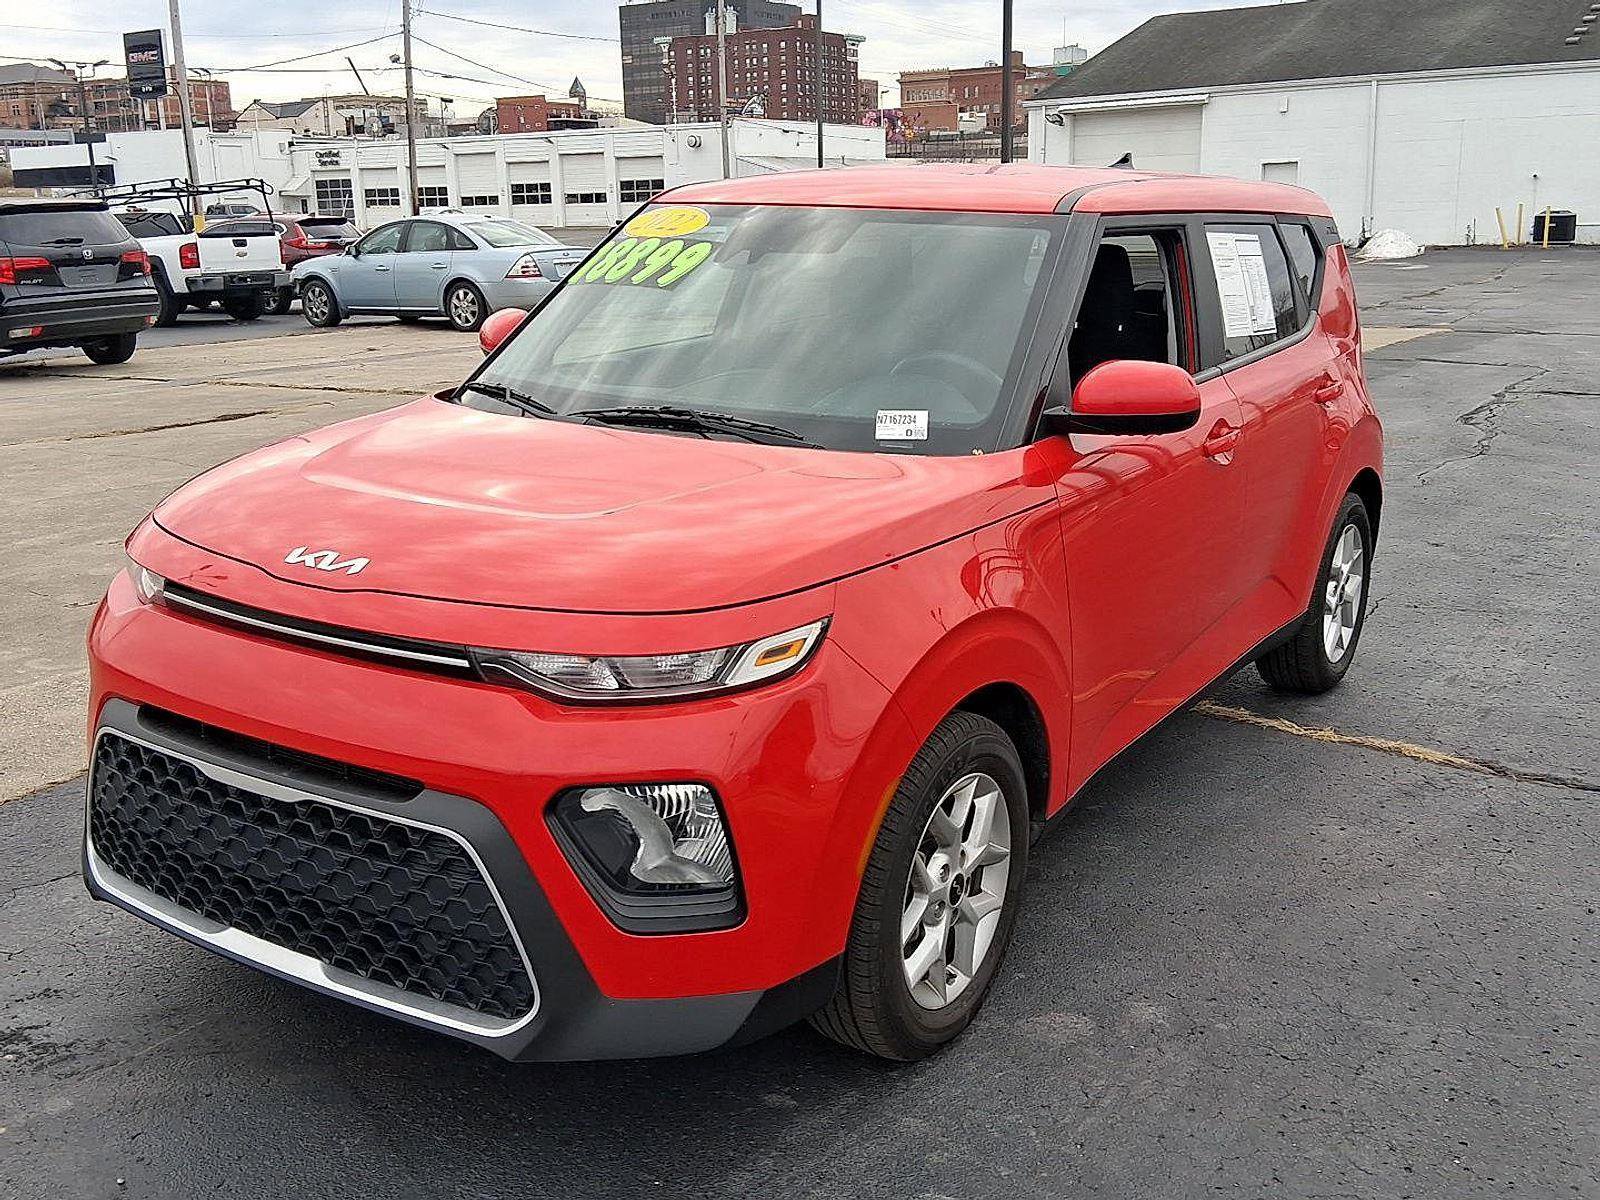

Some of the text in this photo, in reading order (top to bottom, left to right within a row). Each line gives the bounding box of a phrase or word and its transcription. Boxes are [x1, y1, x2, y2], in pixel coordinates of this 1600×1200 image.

[128, 50, 158, 63] GMC
[315, 150, 340, 158] Certified
[567, 237, 713, 288] 18899
[877, 414, 917, 425] N7167234
